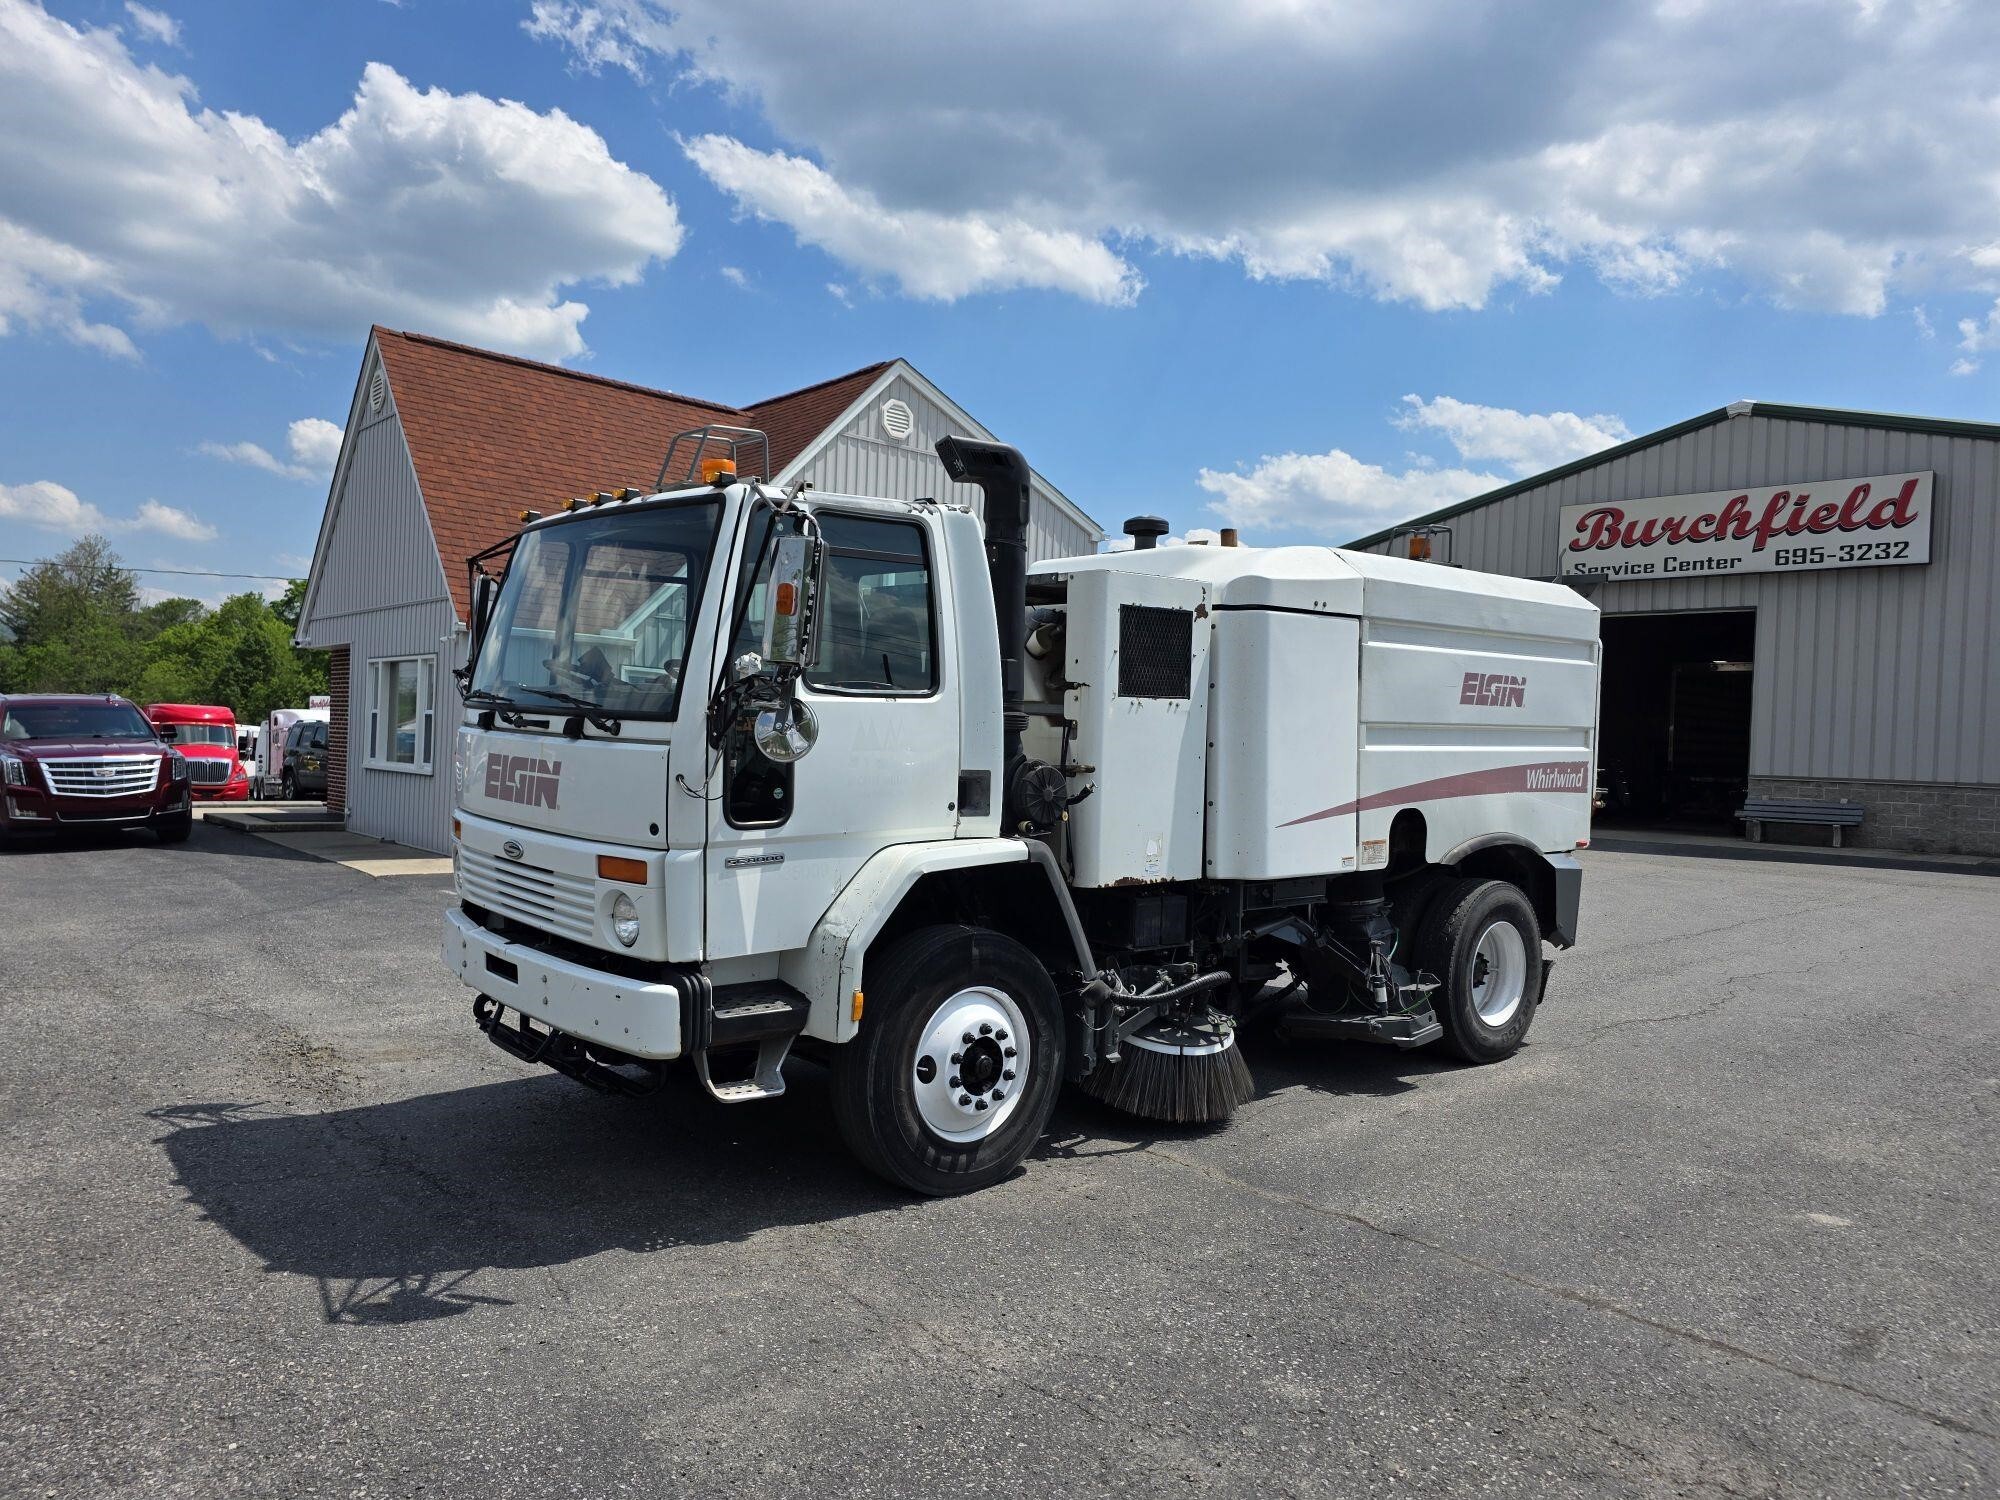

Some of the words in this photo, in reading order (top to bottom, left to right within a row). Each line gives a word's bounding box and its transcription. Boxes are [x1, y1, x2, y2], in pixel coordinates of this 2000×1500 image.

[1568, 478, 1920, 553] Burchfield
[1573, 561, 1655, 575] Service
[1664, 556, 1742, 573] Center
[1774, 541, 1910, 566] 695-3232
[1459, 672, 1527, 708] ELGIN
[485, 752, 562, 810] ELGIN
[1526, 767, 1584, 789] Whirlwind
